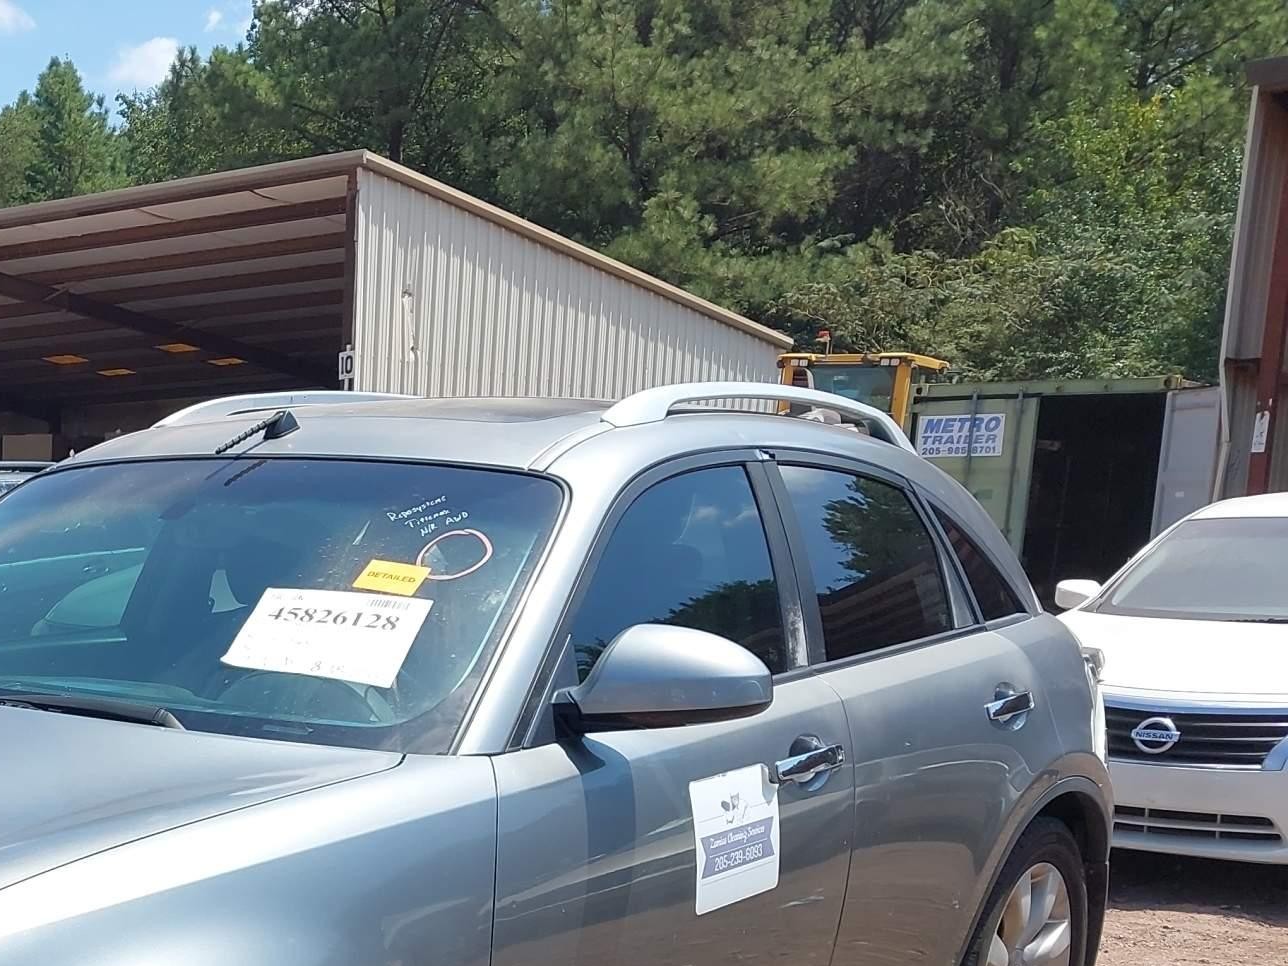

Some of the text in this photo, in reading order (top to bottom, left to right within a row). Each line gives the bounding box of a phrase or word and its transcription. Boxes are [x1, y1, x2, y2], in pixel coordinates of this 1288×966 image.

[923, 417, 1002, 434] METRO
[921, 434, 998, 446] TRAILER
[445, 511, 469, 525] AWD
[367, 570, 416, 583] DETAILED
[268, 606, 400, 631] 45826128
[1135, 731, 1174, 740] NISSAN
